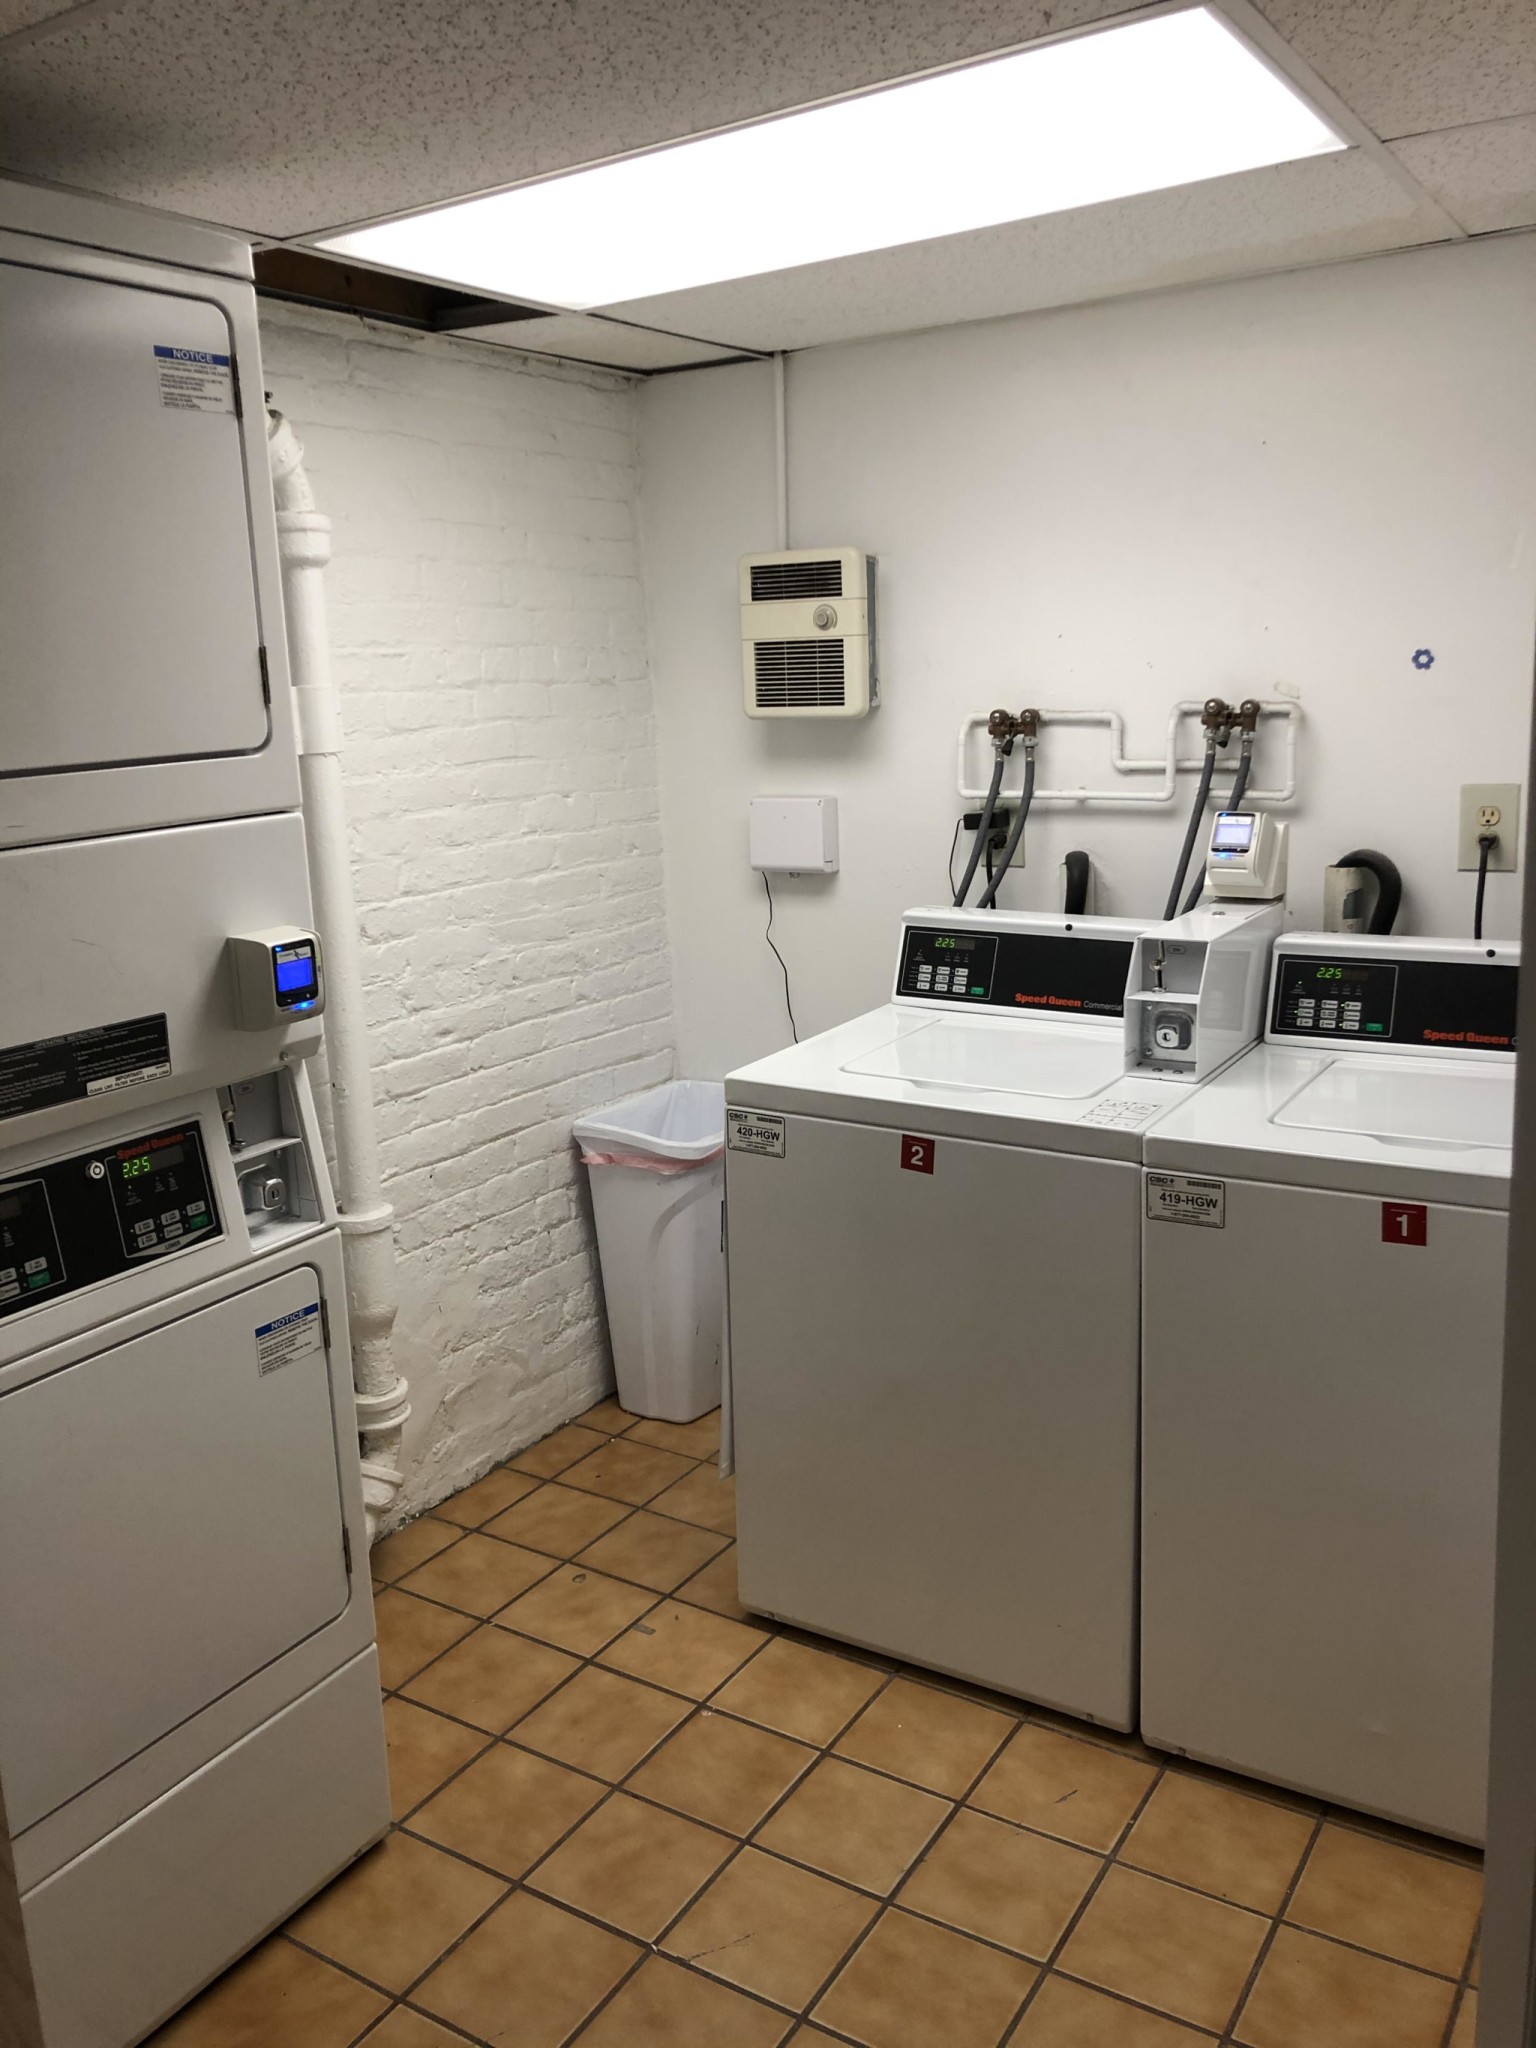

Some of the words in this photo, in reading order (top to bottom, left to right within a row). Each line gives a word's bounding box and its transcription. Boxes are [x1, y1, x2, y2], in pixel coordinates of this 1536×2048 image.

[172, 348, 213, 363] NOTICE
[1015, 992, 1047, 1004] Speed
[1048, 996, 1082, 1008] Queen
[1083, 1000, 1123, 1012] Commercial
[1423, 1029, 1464, 1042] Speed
[1466, 1032, 1509, 1045] Queen
[736, 1126, 780, 1141] 420-HGW
[910, 1145, 924, 1166] 2
[122, 1156, 150, 1178] 2.25
[1149, 1175, 1169, 1184] CSC
[1159, 1192, 1219, 1209] 419-HGW
[1395, 1214, 1408, 1237] 1
[270, 1309, 306, 1330] NOTICE
